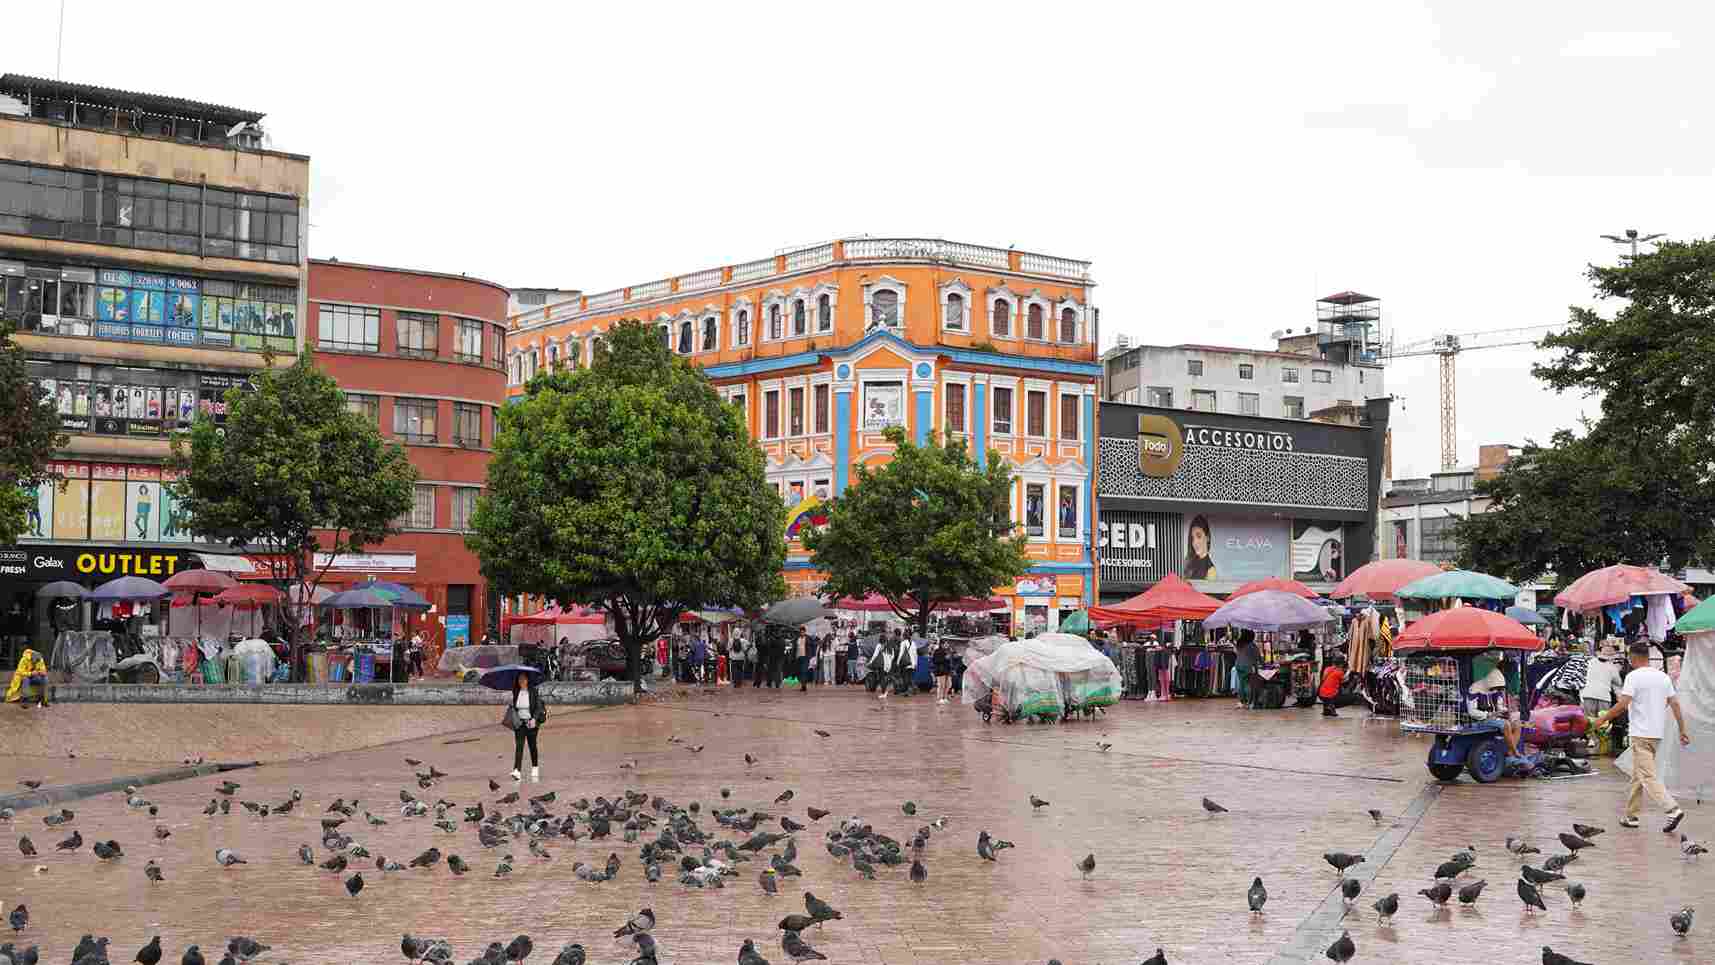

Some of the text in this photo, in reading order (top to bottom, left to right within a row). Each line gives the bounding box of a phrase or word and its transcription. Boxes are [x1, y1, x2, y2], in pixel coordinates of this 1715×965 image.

[1143, 439, 1167, 450] Todo
[1186, 429, 1293, 450] ACCESORIOS
[34, 556, 64, 569] Galax
[76, 553, 179, 575] OUTLET
